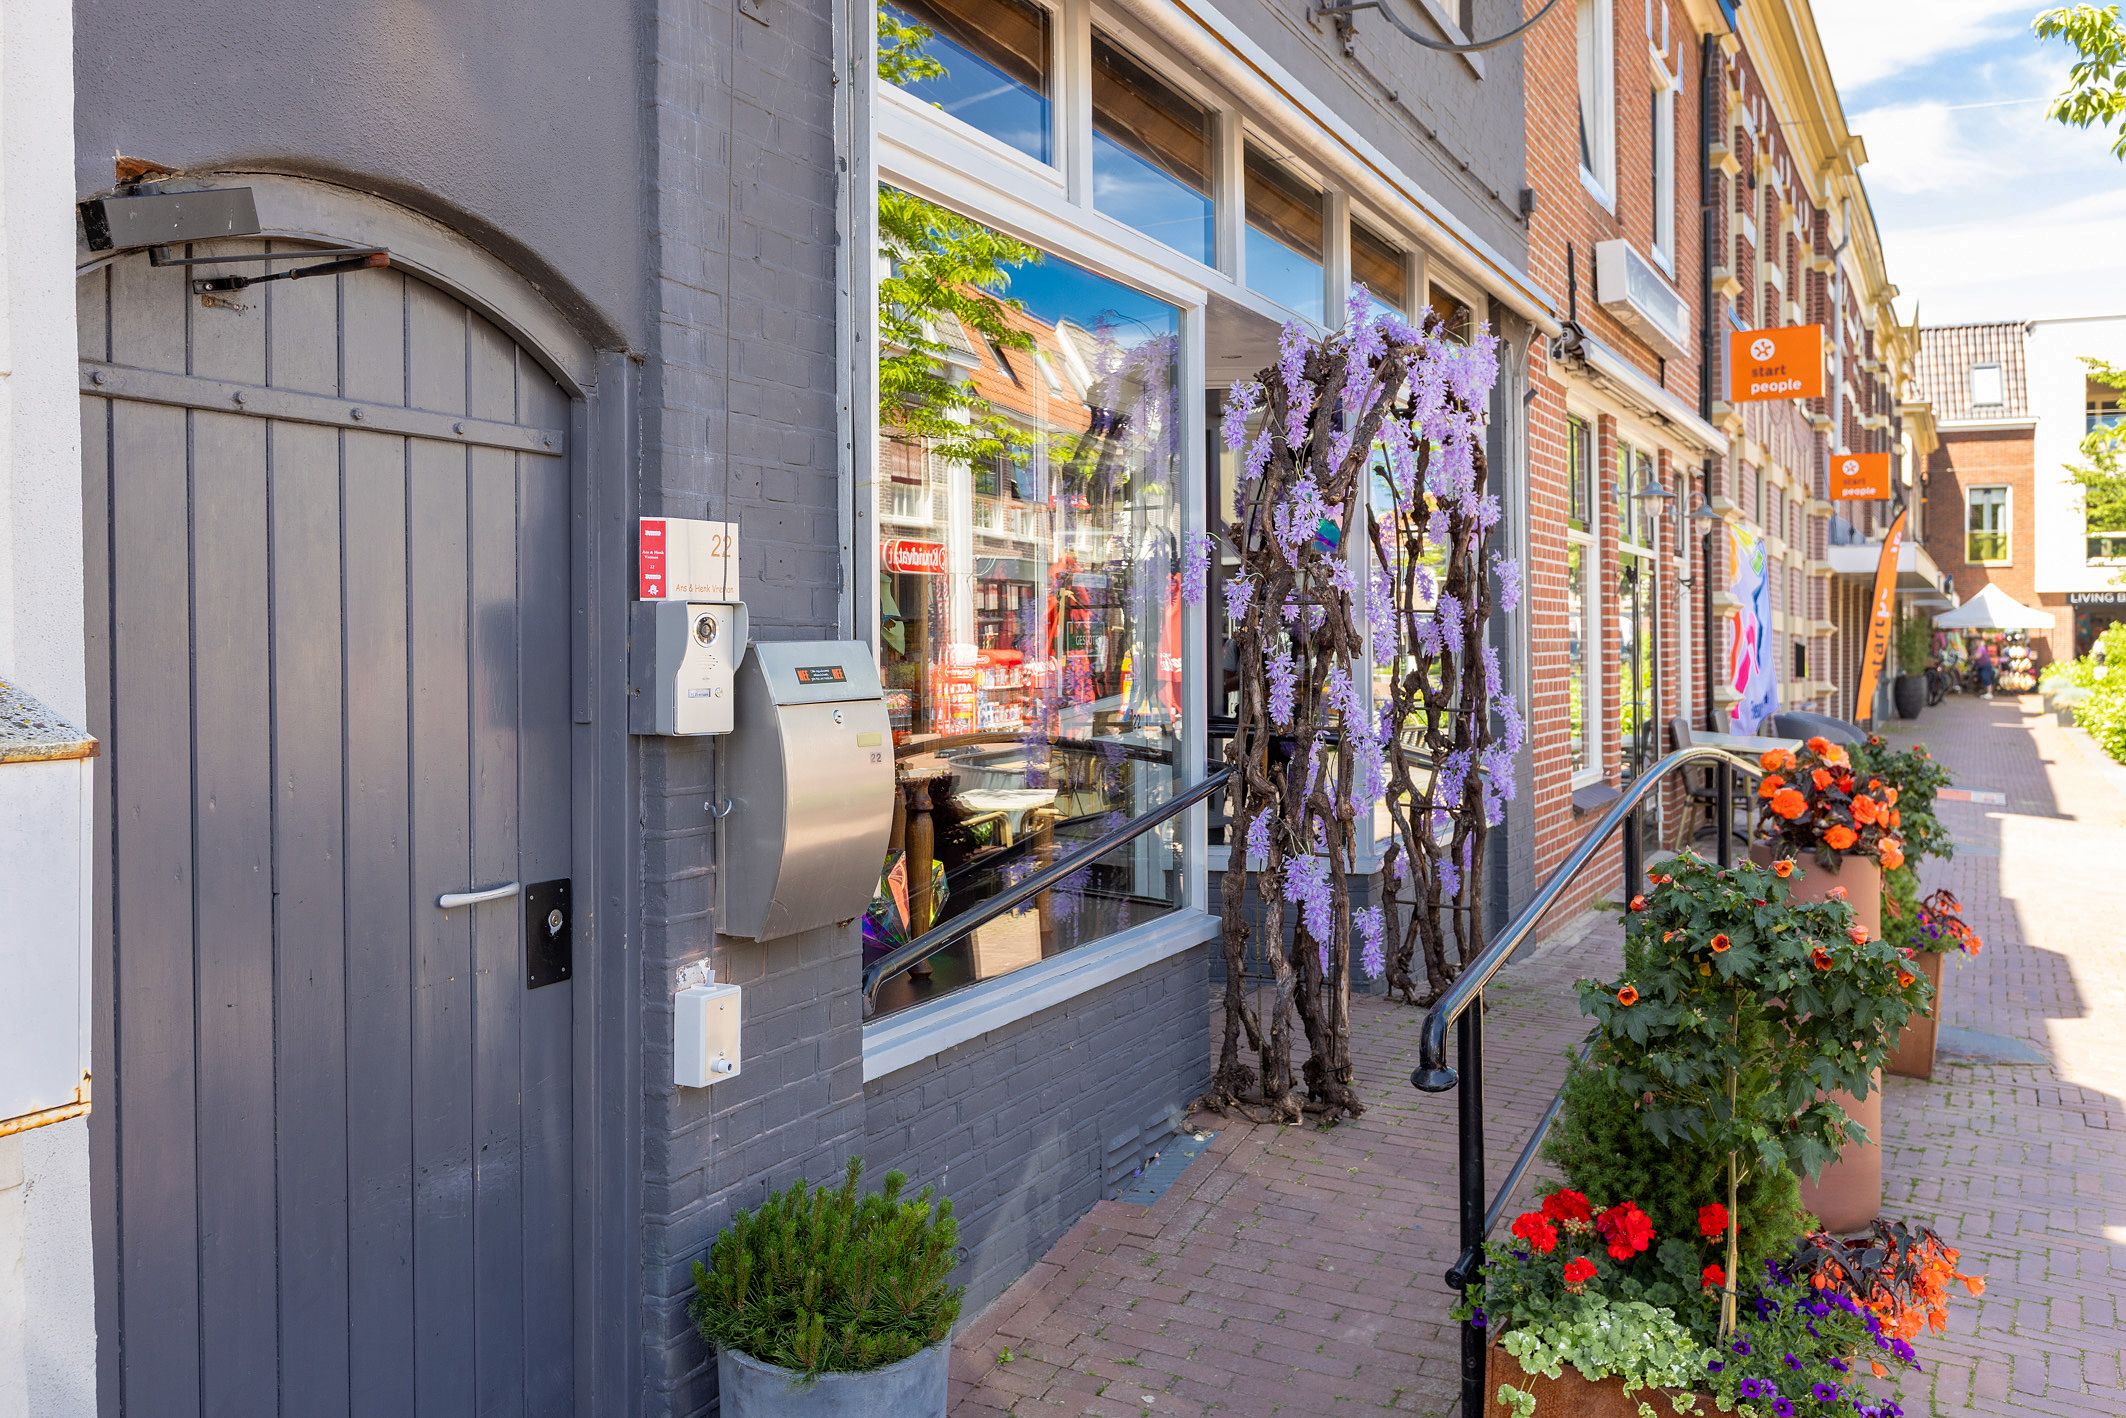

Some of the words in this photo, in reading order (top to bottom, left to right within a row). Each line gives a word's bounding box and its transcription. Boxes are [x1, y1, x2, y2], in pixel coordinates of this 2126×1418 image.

[1751, 365, 1787, 378] start
[1751, 378, 1802, 396] people
[1842, 486, 1877, 497] people
[711, 534, 732, 558] 22
[689, 584, 694, 593] &
[2070, 592, 2115, 604] LIVING
[870, 752, 882, 763] 22
